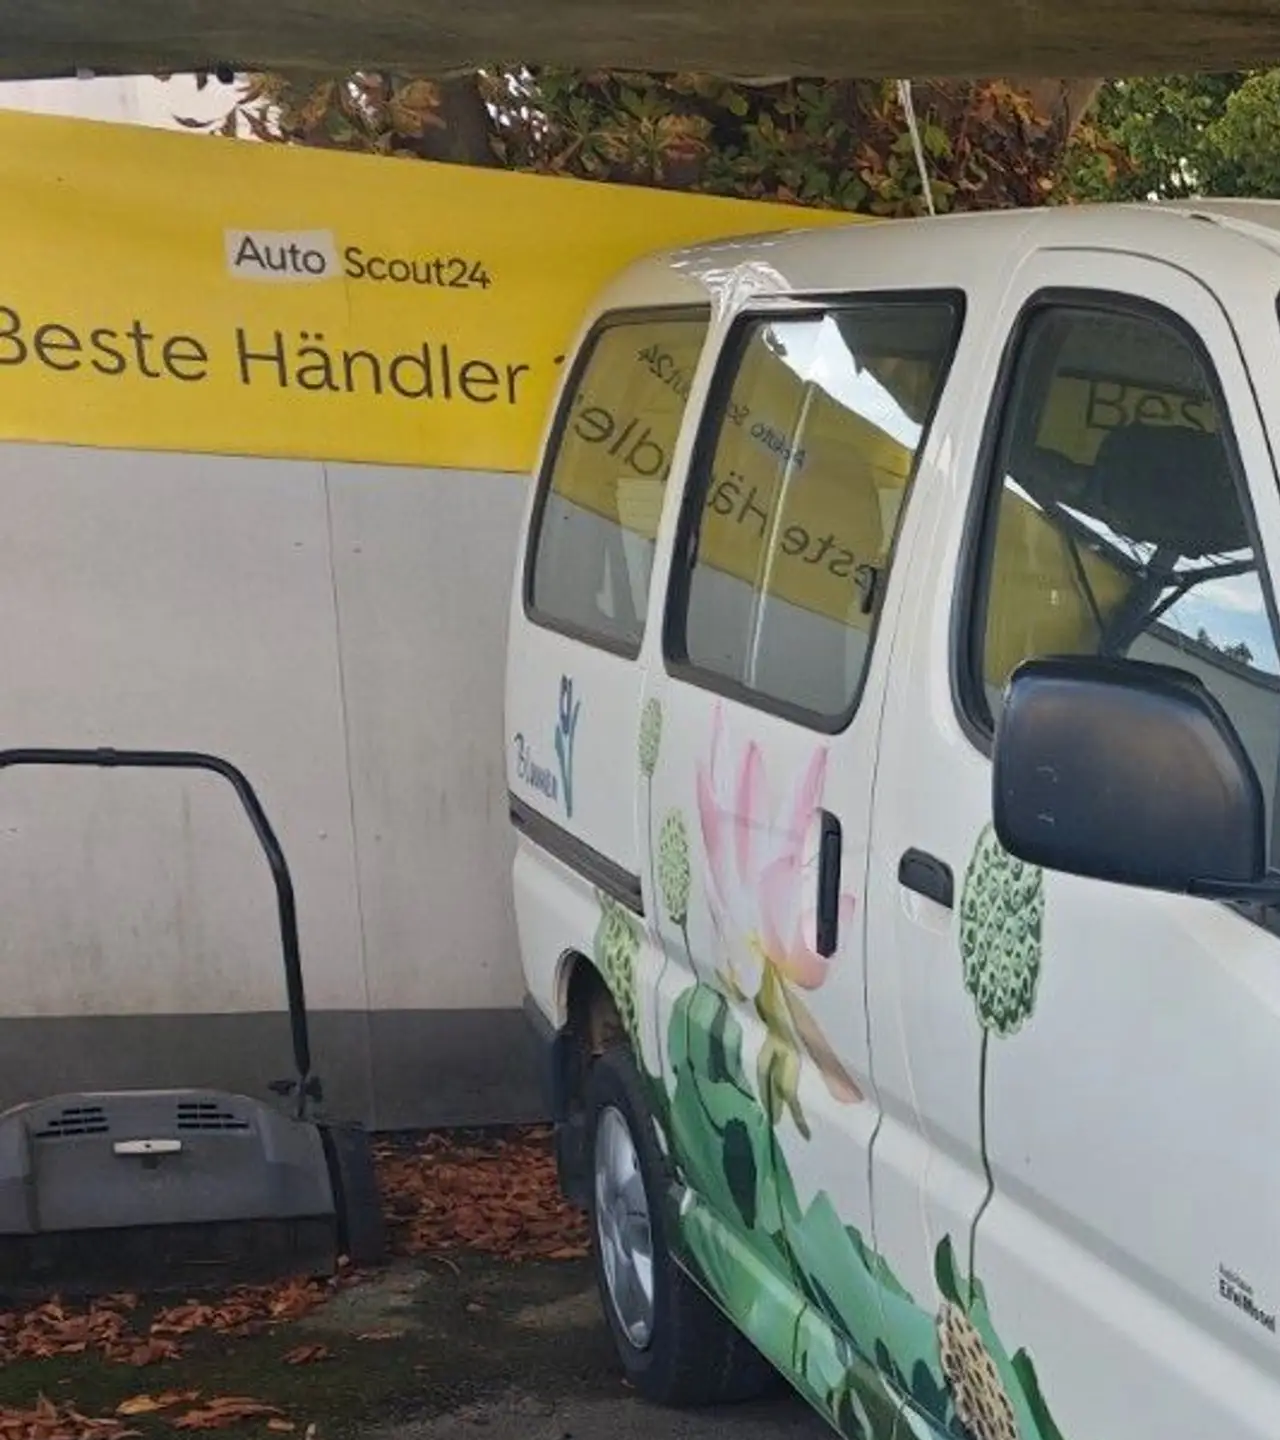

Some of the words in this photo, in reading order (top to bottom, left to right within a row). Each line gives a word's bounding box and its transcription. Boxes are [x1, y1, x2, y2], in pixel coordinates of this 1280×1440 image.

[235, 236, 326, 275] Auto
[344, 246, 491, 289] Scout24
[0, 304, 208, 381] Beste
[236, 328, 529, 404] Händler
[1086, 379, 1209, 431] Bes
